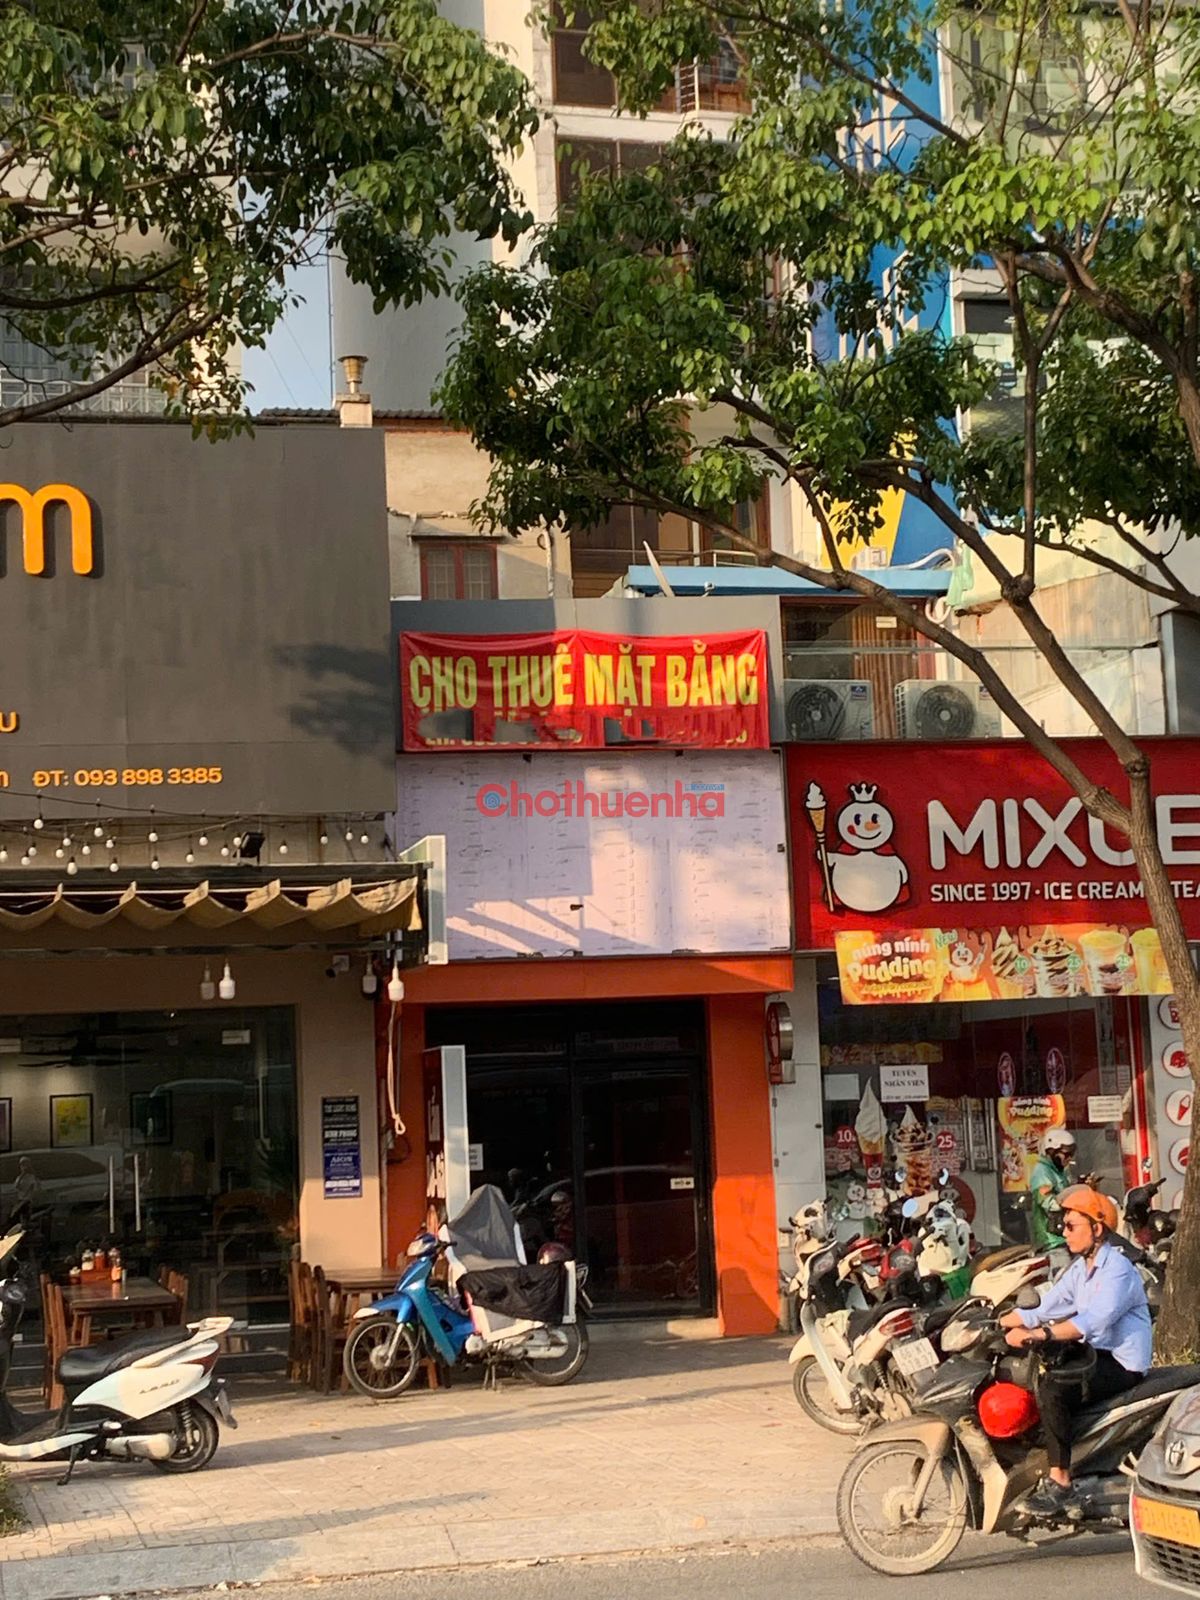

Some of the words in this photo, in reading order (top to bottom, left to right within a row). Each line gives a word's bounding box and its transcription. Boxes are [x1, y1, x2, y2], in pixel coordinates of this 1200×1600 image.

[409, 655, 478, 708] CHO
[488, 642, 574, 708] THUÊ
[584, 643, 656, 717] MẶT
[666, 639, 759, 707] BẰNG
[32, 769, 70, 787] ĐT:
[73, 769, 118, 787] 093
[121, 768, 164, 785] 898
[167, 766, 223, 785] 3385
[930, 883, 987, 902] SINCE
[991, 881, 1032, 901] 1997
[1043, 881, 1073, 900] ICE
[1077, 881, 1145, 900] CREAM
